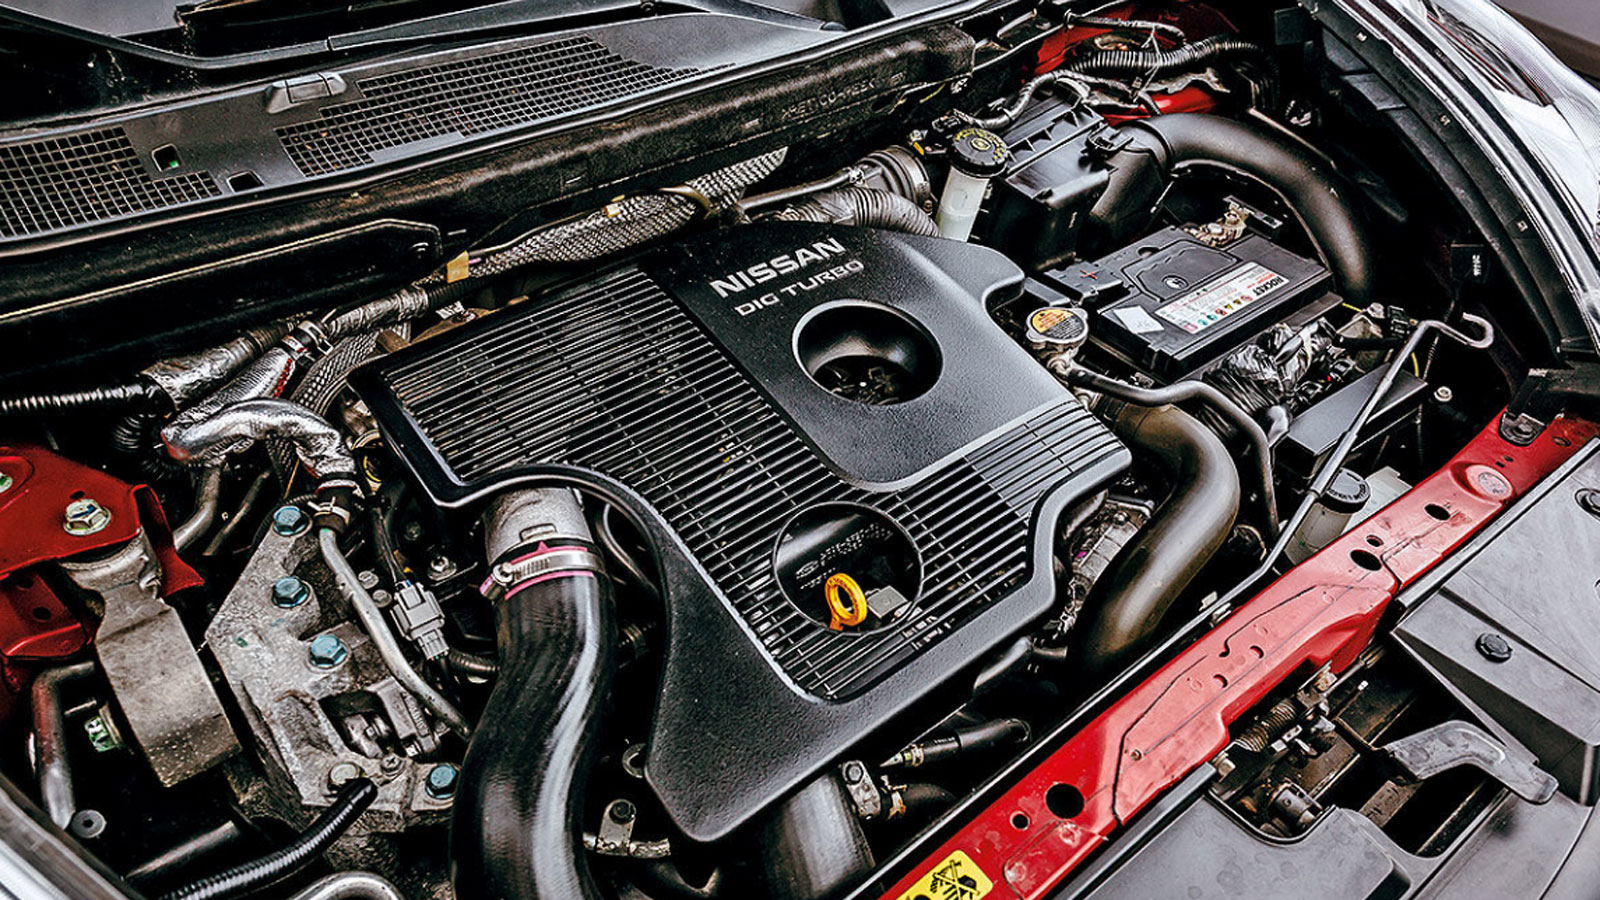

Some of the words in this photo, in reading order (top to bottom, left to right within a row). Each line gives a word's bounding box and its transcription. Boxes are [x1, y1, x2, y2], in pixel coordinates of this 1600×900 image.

[709, 237, 847, 298] NISSAN
[734, 292, 780, 316] DIG
[780, 259, 865, 297] TURBO
